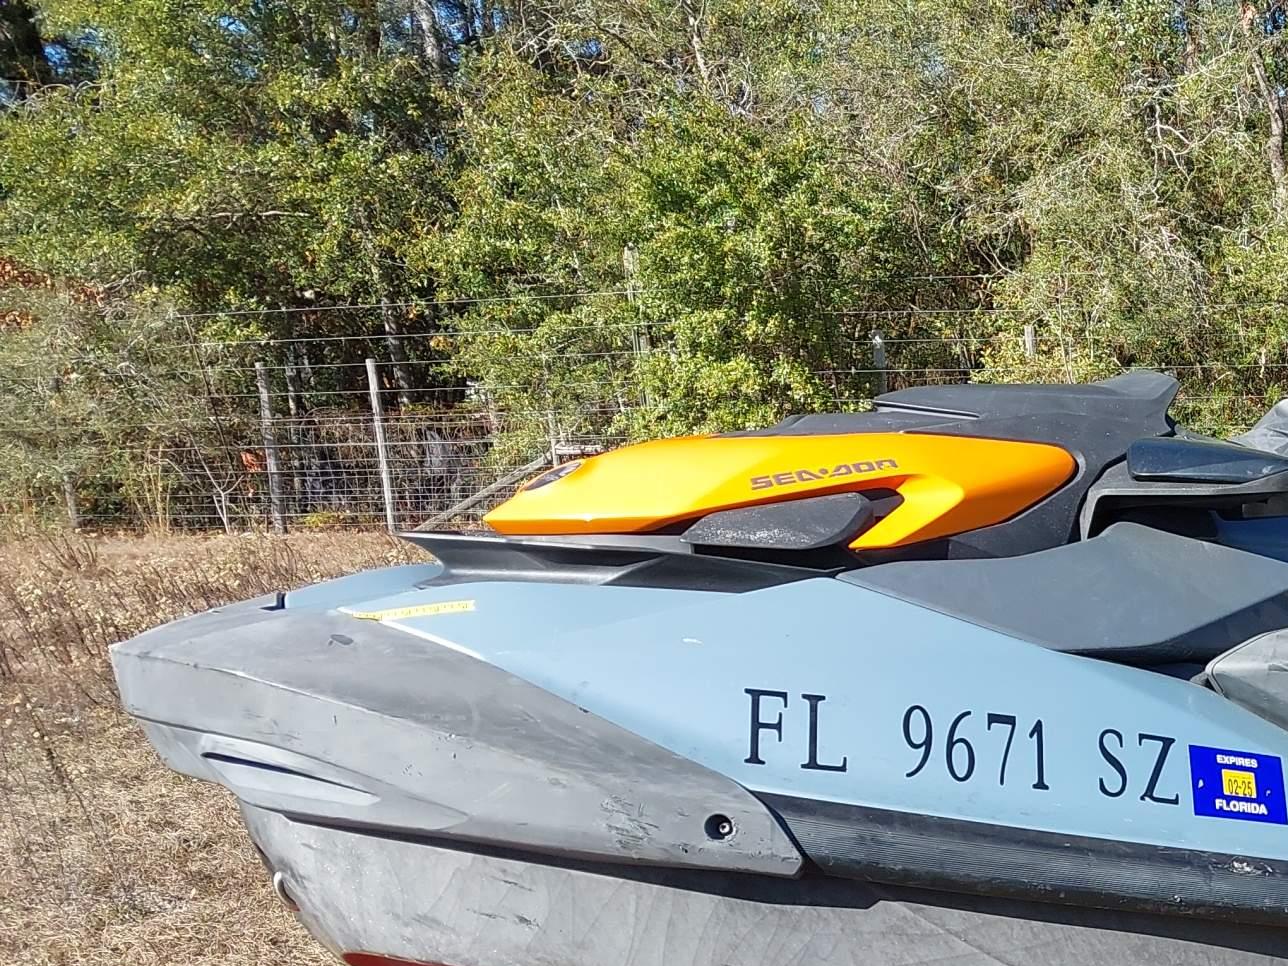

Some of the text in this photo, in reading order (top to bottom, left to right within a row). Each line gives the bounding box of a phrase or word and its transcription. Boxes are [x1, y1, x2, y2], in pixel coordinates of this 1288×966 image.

[743, 687, 1180, 805] FL 9671 SZ
[1216, 754, 1258, 768] EXPIRES
[1227, 778, 1254, 797] 02-25
[1215, 798, 1268, 815] FLORIDA
